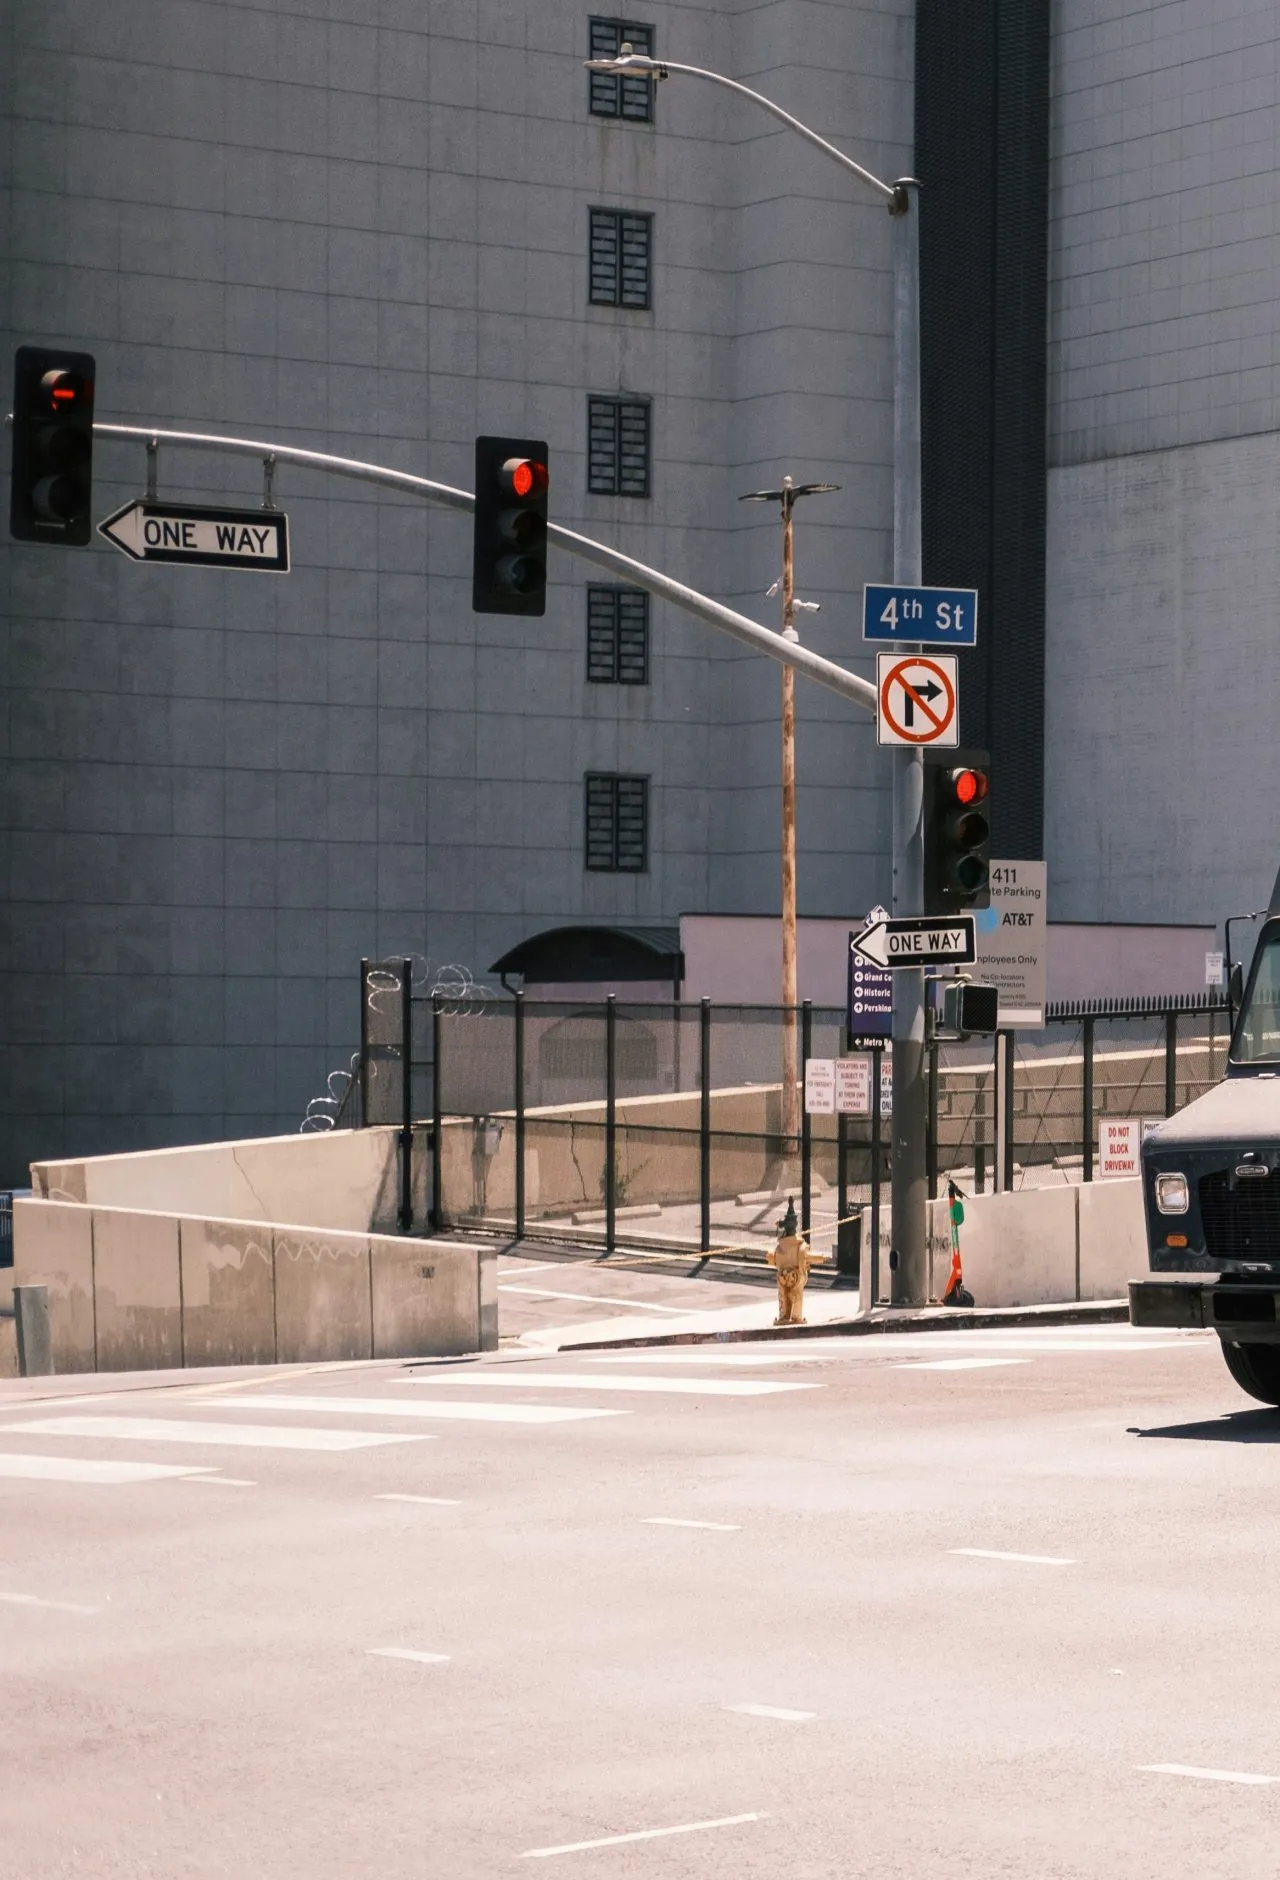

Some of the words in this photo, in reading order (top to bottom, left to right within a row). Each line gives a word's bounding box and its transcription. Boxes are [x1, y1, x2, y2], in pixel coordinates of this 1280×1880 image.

[144, 519, 197, 548] ONE
[216, 525, 270, 554] WAY
[880, 597, 922, 631] 4th
[935, 602, 964, 631] St
[992, 868, 1016, 884] 411
[1003, 886, 1041, 899] Parking
[1002, 913, 1034, 926] AT&T
[889, 934, 922, 953] ONE
[928, 932, 961, 951] WAY
[977, 954, 1016, 966] mployees
[1017, 954, 1038, 966] Only
[864, 973, 883, 982] Grand
[864, 988, 891, 997] Historic
[863, 1038, 883, 1047] Metro
[881, 1102, 893, 1111] ONL
[1108, 1127, 1117, 1137] DO
[1118, 1127, 1130, 1137] NOT
[1109, 1144, 1129, 1155] BLOCK
[1104, 1160, 1135, 1171] DRIVEWAY
